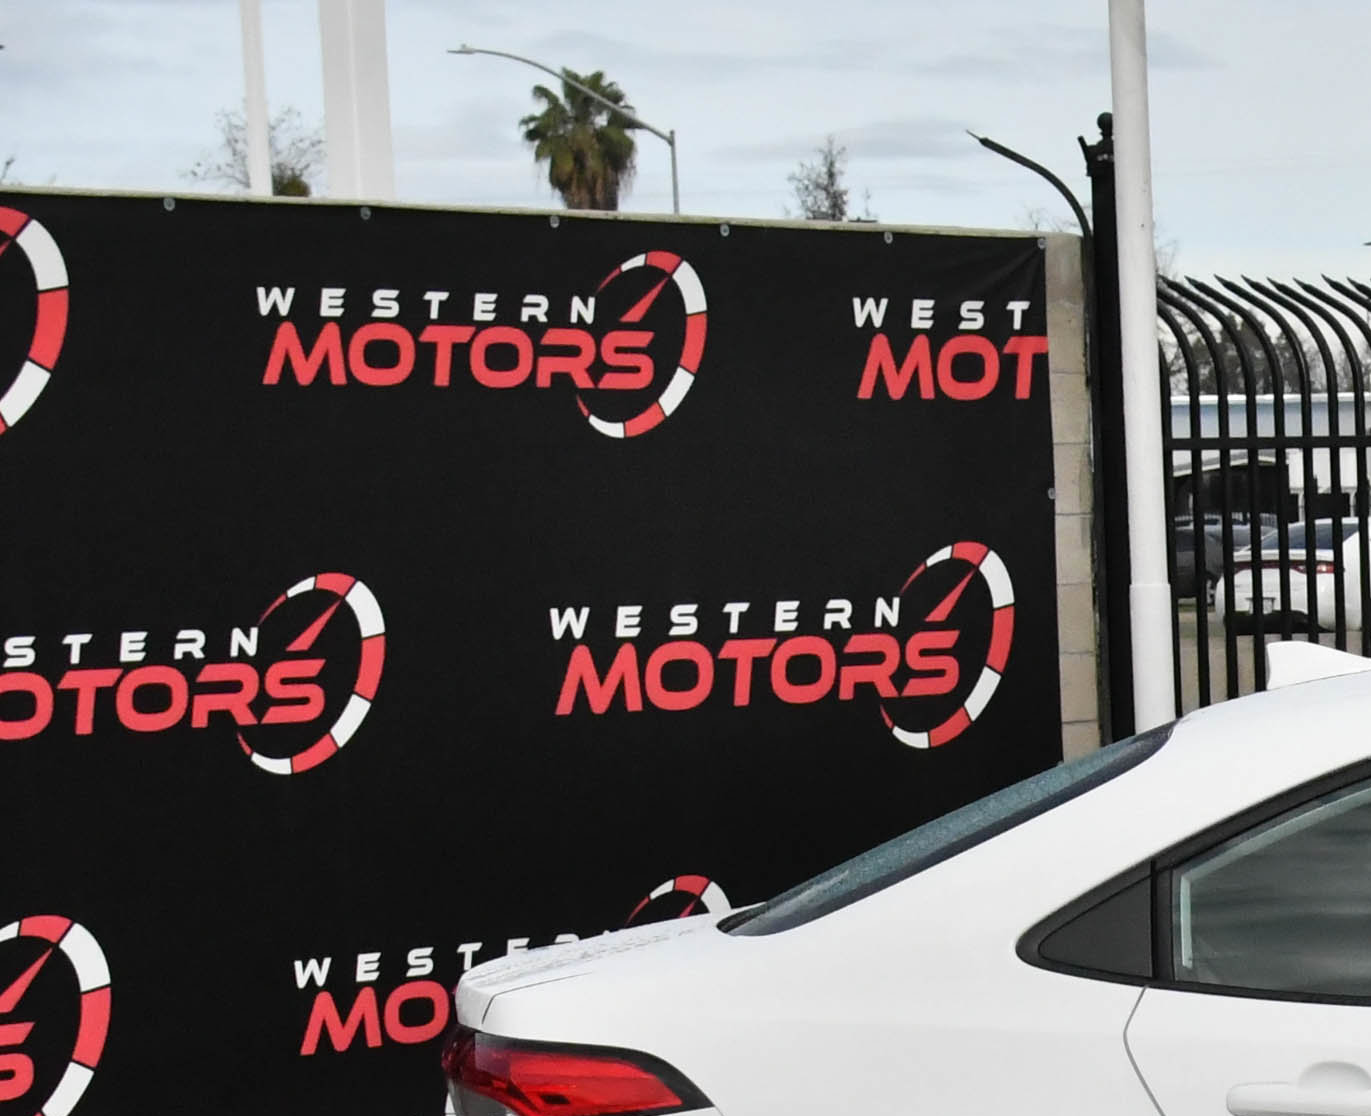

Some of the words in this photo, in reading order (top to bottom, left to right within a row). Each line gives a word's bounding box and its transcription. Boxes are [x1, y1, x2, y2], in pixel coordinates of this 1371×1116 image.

[256, 286, 597, 325] WESTERN
[852, 297, 1031, 331] WEST
[263, 321, 655, 390] MOTORS
[857, 332, 1050, 401] MOT
[3, 626, 259, 668] STERN
[549, 596, 901, 641] WESTERN
[555, 629, 960, 716] MOTORS
[300, 980, 457, 1056] MO
